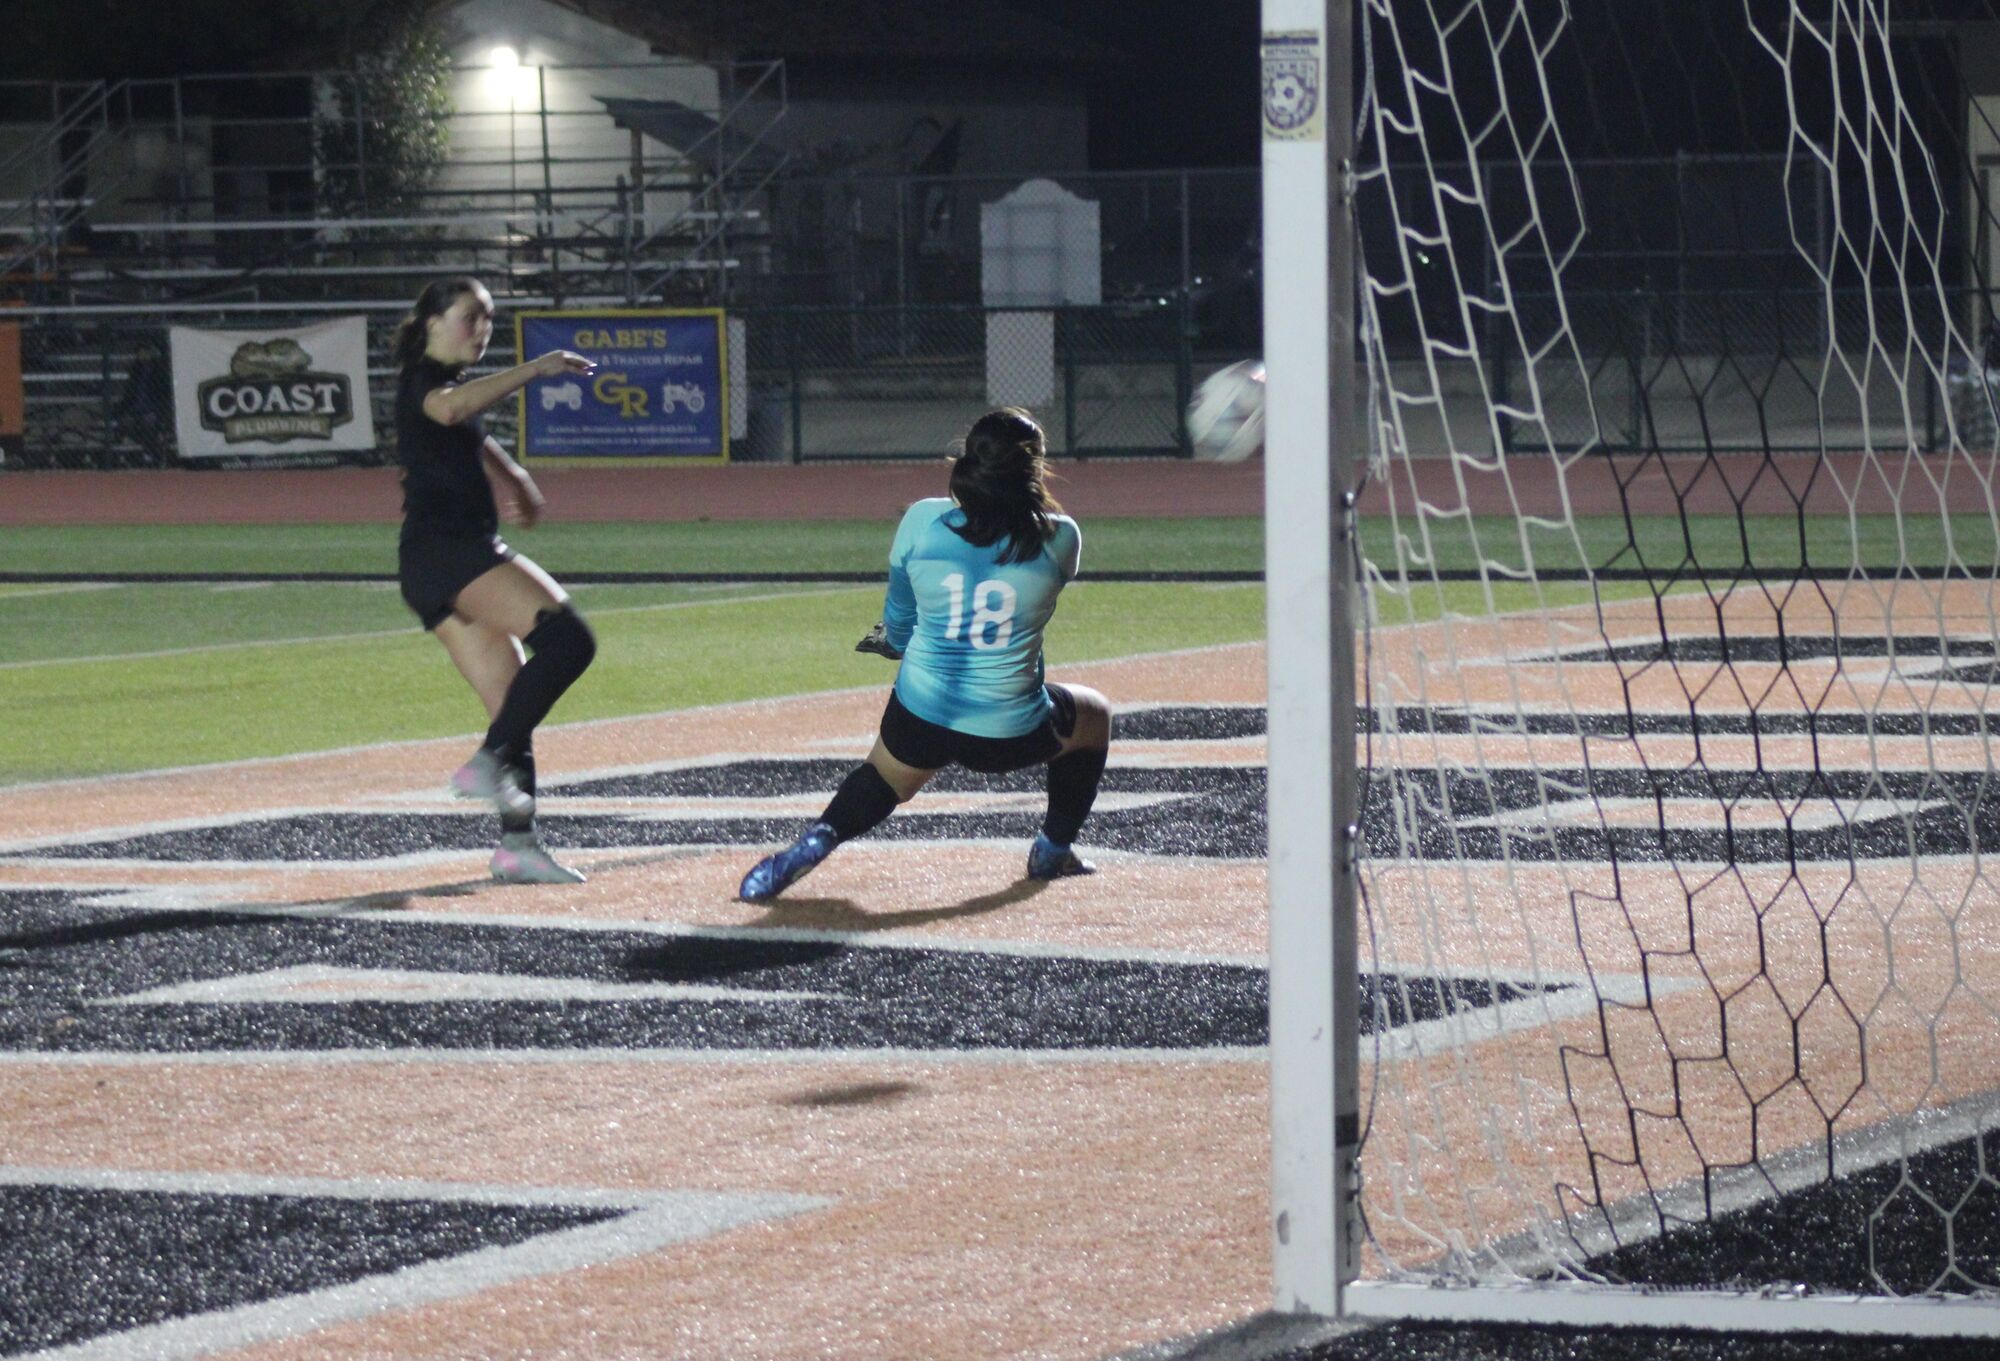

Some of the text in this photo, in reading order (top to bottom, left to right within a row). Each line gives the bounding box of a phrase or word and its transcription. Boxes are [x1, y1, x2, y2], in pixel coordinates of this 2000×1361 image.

[574, 329, 667, 348] GABE'S
[209, 383, 341, 417] COAST
[235, 418, 320, 436] PLUMBING
[940, 573, 1017, 650] 18
